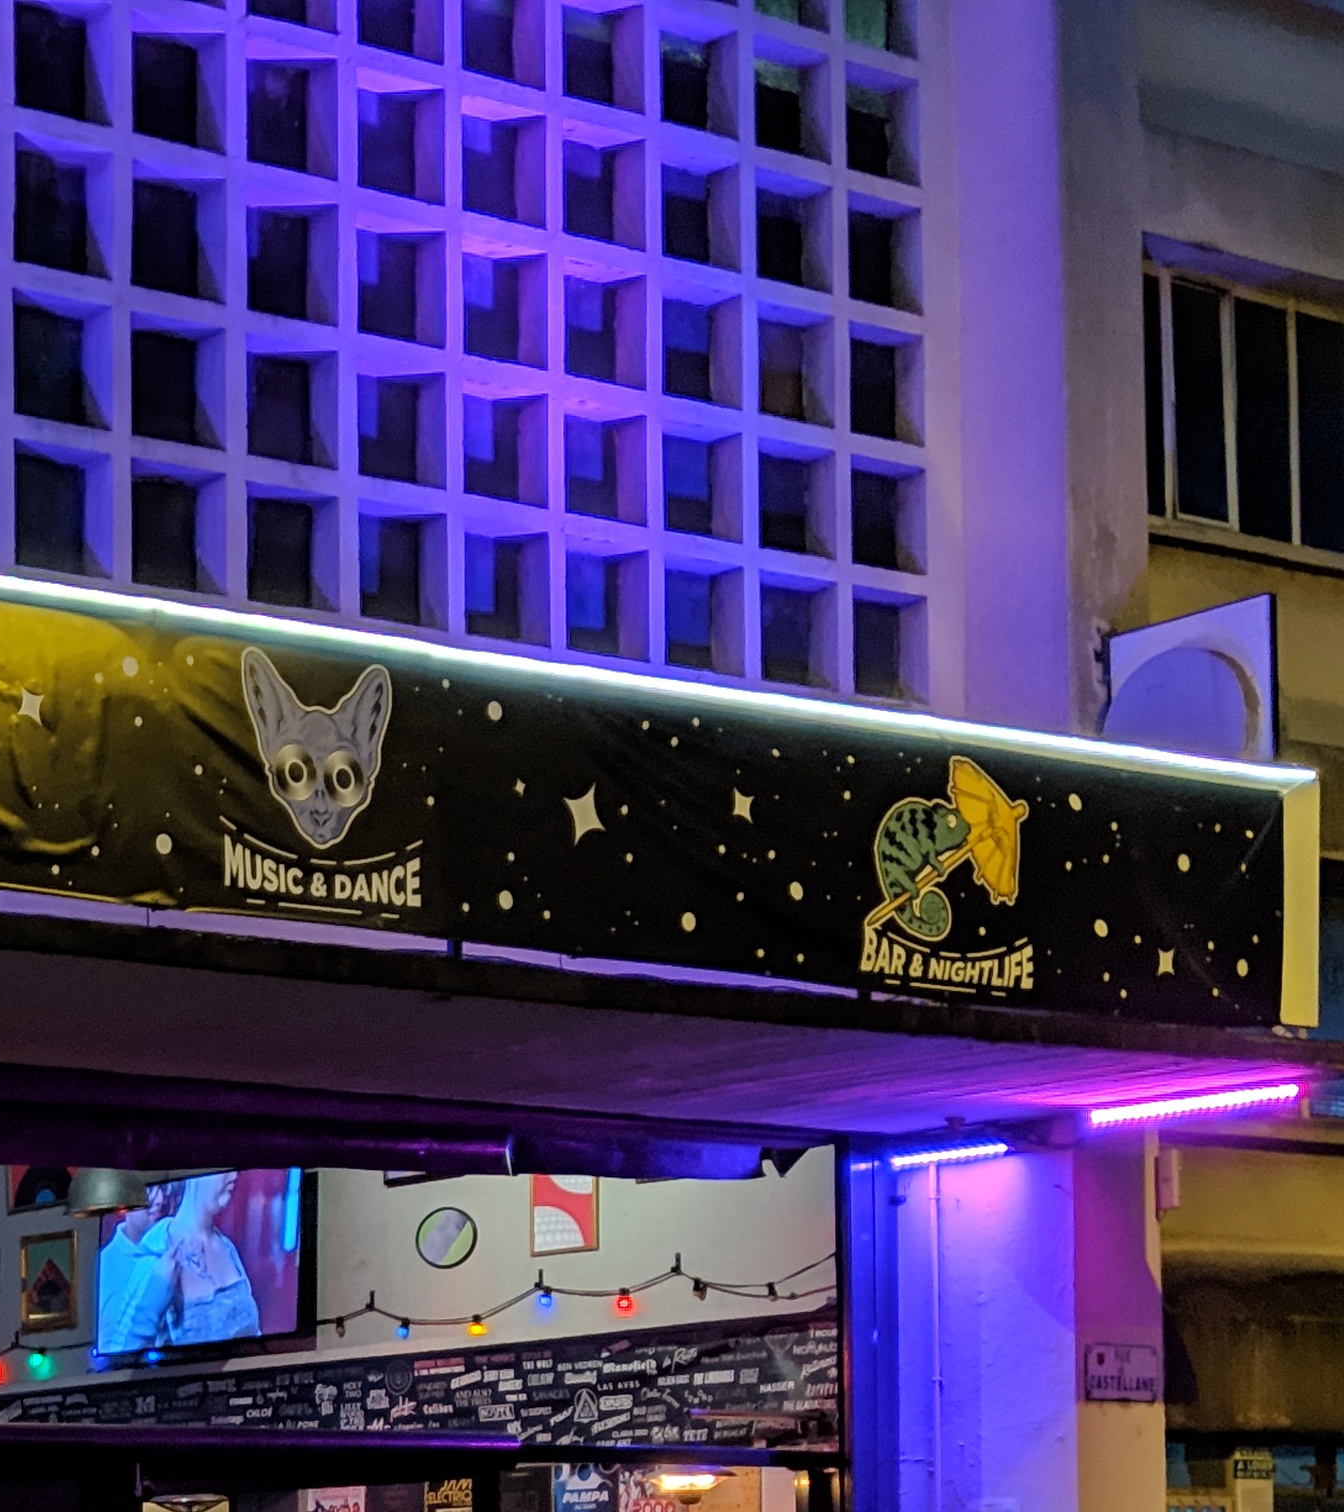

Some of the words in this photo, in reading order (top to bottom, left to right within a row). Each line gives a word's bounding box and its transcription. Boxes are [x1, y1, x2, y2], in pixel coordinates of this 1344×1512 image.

[223, 834, 304, 896] MUSIC
[310, 872, 328, 898] &
[334, 857, 422, 907] DANCE
[860, 924, 907, 975] BAR
[908, 953, 924, 978] &
[928, 944, 1034, 990] NIGHTLIFE
[759, 1380, 795, 1394] NASSER
[439, 1478, 472, 1491] JAM
[562, 1490, 609, 1504] PAMPA
